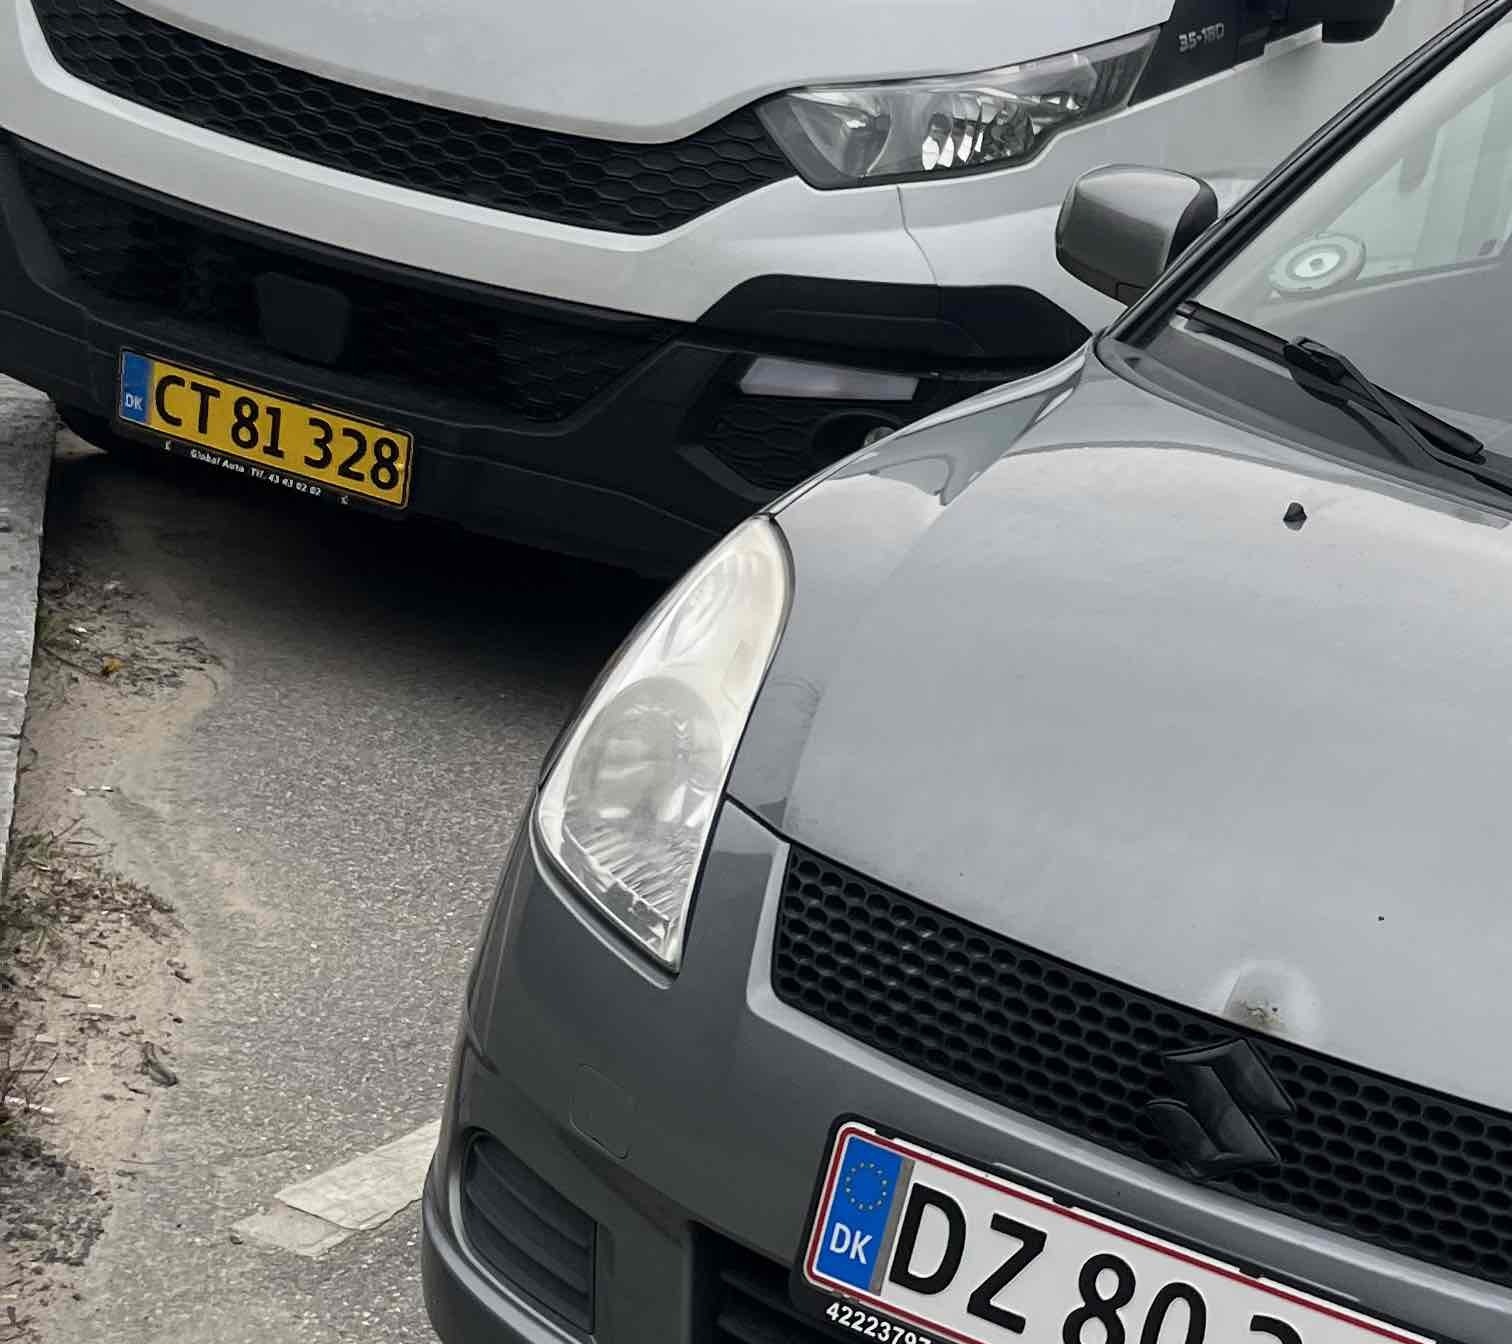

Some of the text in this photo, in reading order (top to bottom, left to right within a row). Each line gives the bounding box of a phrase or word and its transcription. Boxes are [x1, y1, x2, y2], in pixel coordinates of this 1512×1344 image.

[125, 392, 143, 411] DK
[155, 375, 400, 491] CT 81 328
[829, 1222, 873, 1265] DK
[889, 1182, 1048, 1335] DZ
